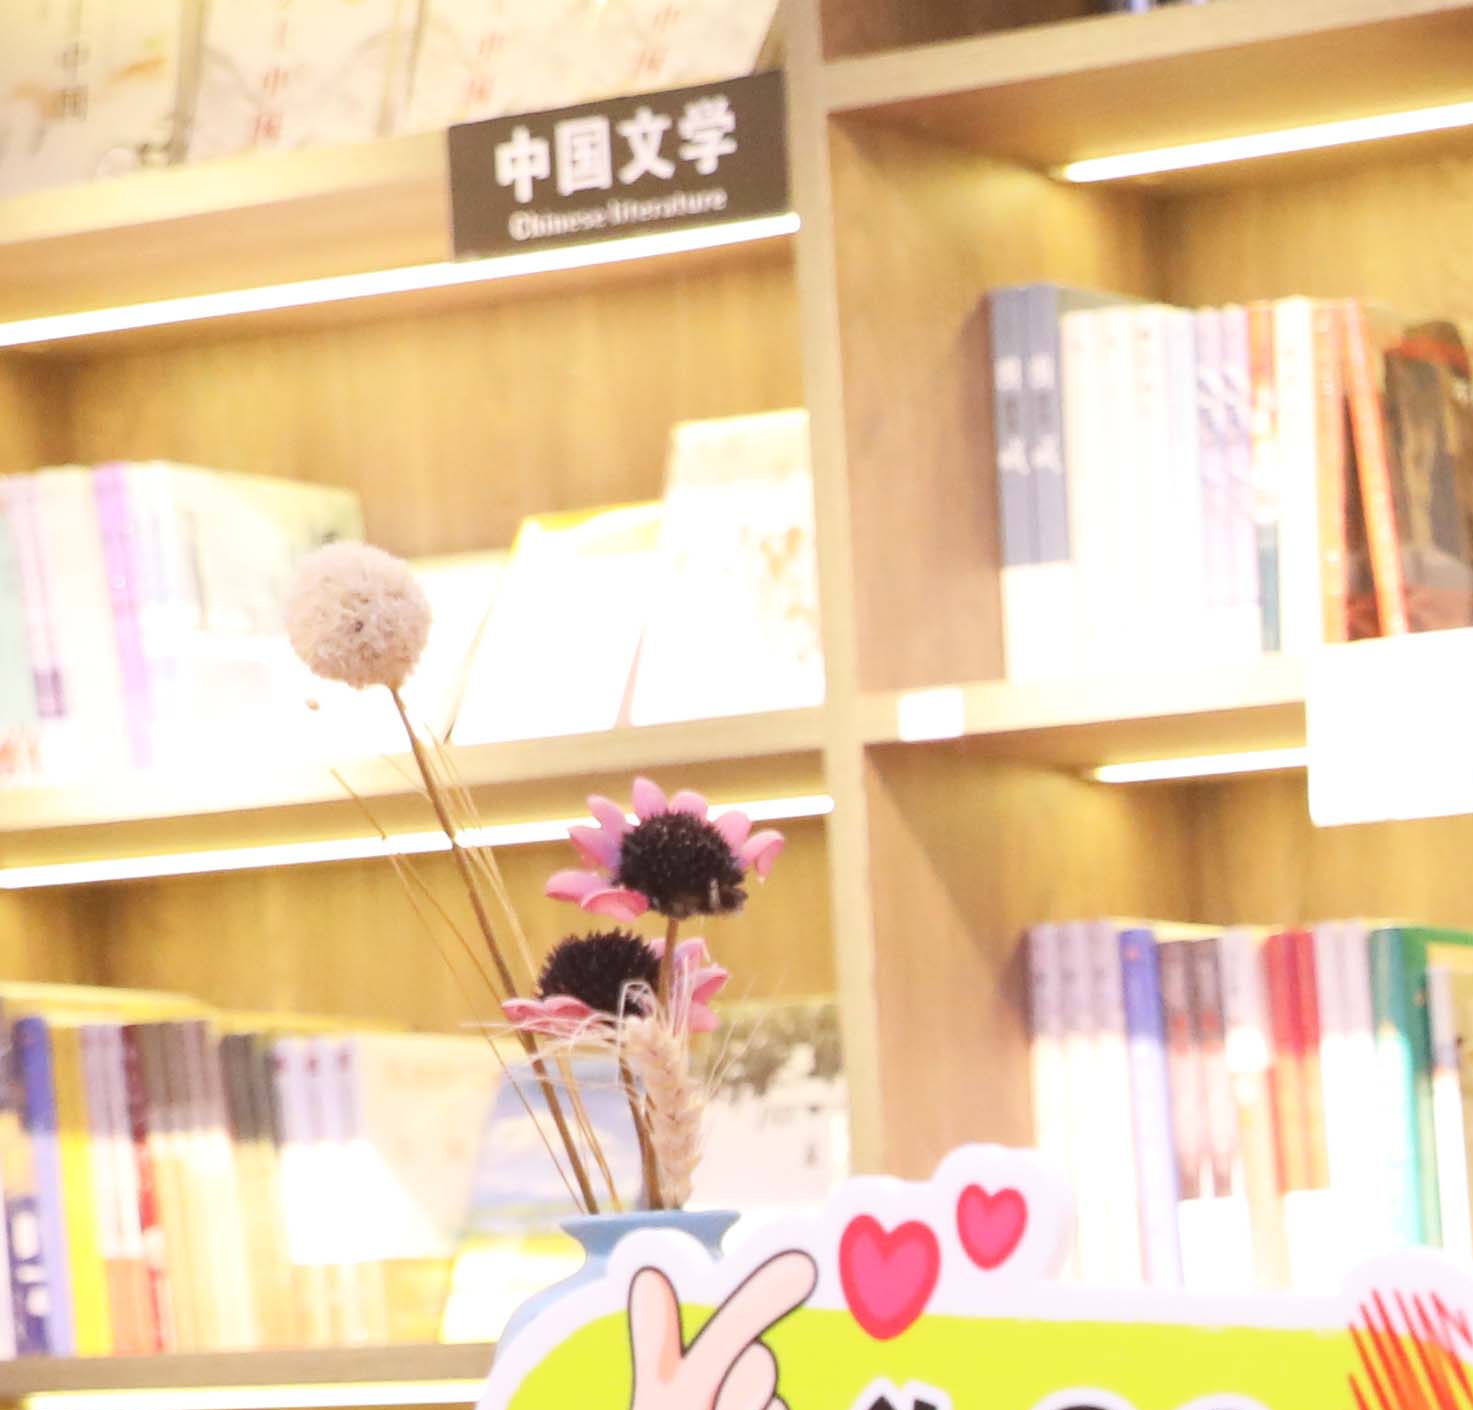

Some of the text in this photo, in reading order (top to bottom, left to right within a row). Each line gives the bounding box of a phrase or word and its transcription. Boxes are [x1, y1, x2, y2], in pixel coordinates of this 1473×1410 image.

[495, 94, 738, 204] 中国文学
[508, 207, 607, 241] Chinese
